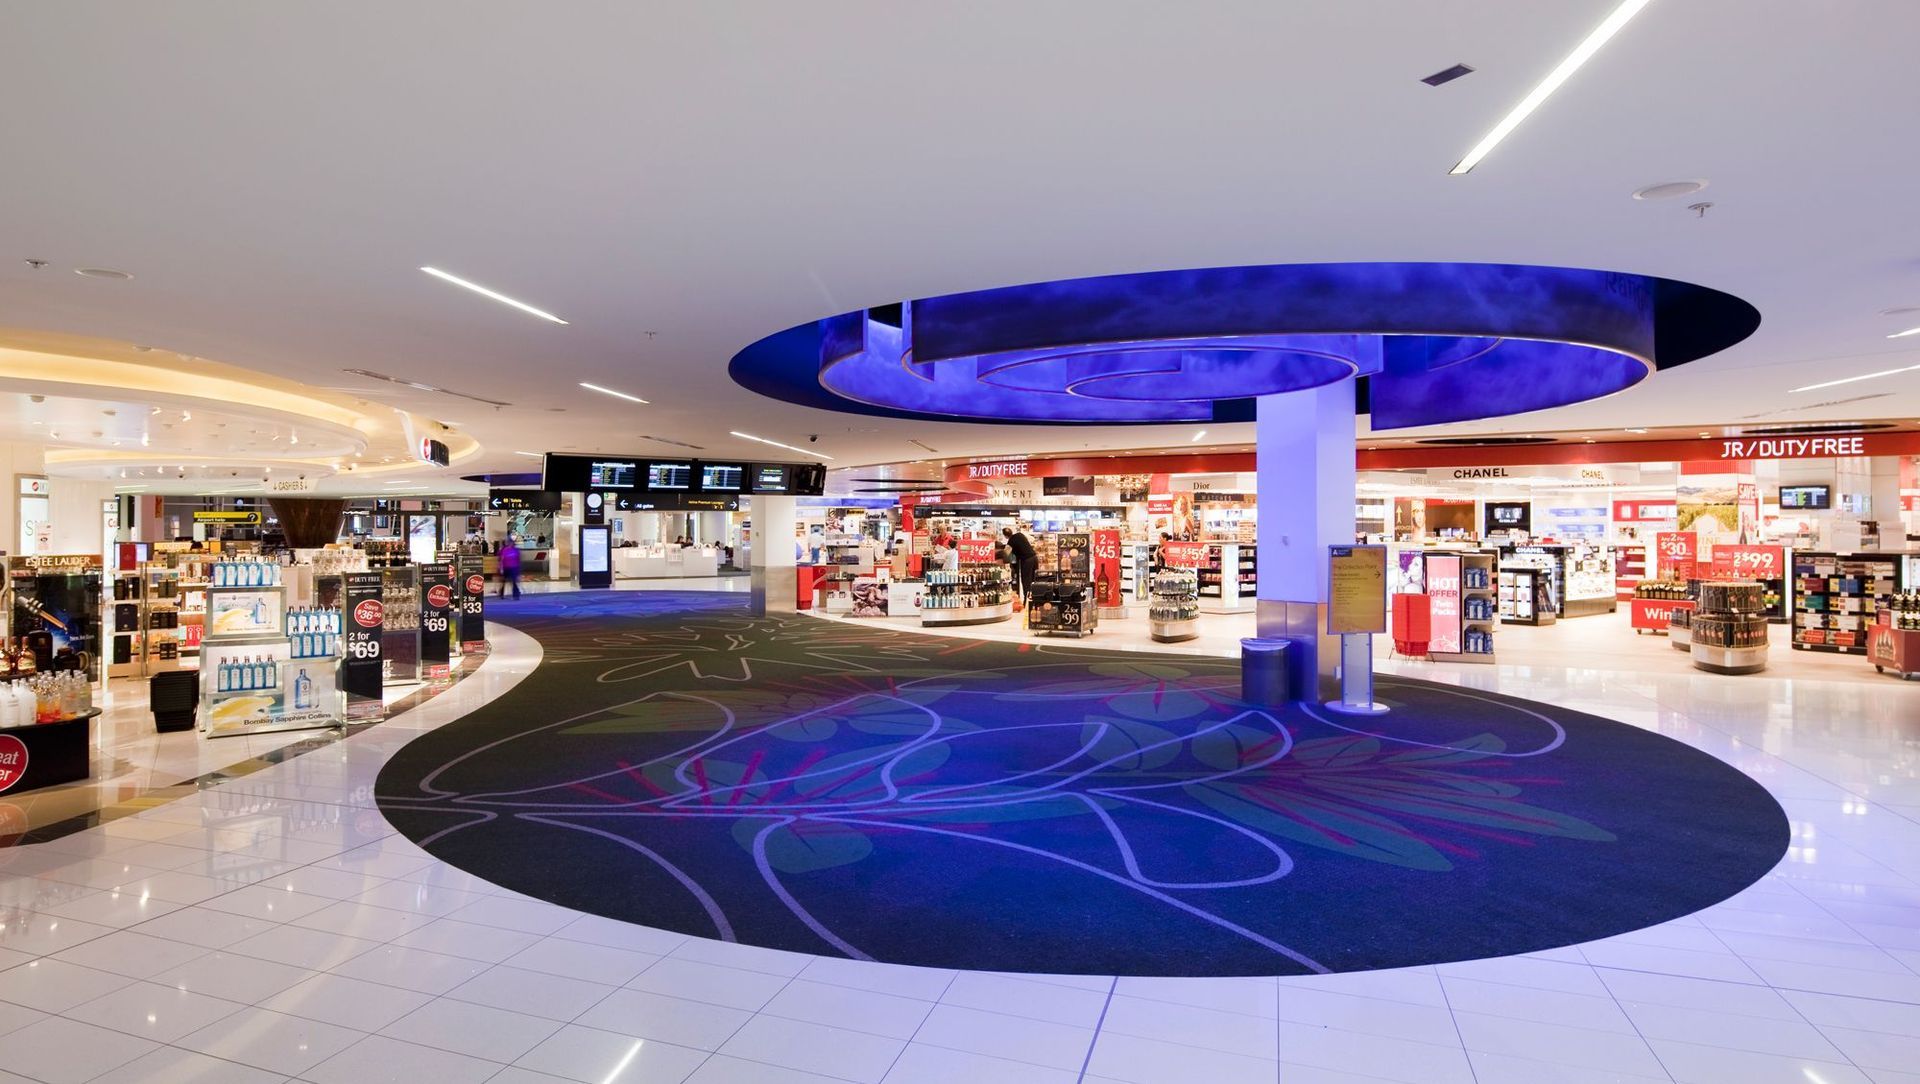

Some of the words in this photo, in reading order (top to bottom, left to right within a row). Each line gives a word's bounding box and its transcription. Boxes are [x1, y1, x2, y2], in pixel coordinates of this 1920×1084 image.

[1812, 437, 1864, 454] FREE
[1453, 467, 1509, 479] CHANEL
[1581, 469, 1605, 480] CHANEL
[1193, 482, 1210, 490] Dior
[1060, 538, 1067, 548] 2
[1100, 534, 1106, 545] 2
[1670, 533, 1677, 541] 2
[975, 545, 990, 557] $69
[1095, 545, 1116, 559] $45
[1187, 548, 1205, 560] $59
[1660, 542, 1687, 556] $30
[55, 556, 91, 567] LAUDER
[1741, 552, 1774, 569] $99
[1429, 577, 1459, 590] HOT
[1430, 590, 1458, 598] OFFER
[363, 602, 379, 611] Save
[463, 602, 482, 614] $33
[1064, 604, 1070, 613] 2
[423, 617, 448, 632] $69
[349, 632, 355, 641] 2
[357, 632, 370, 640] for
[349, 641, 380, 659] $69
[243, 715, 274, 726] Bombay
[275, 713, 307, 723] Sapphire
[307, 712, 332, 720] Collins
